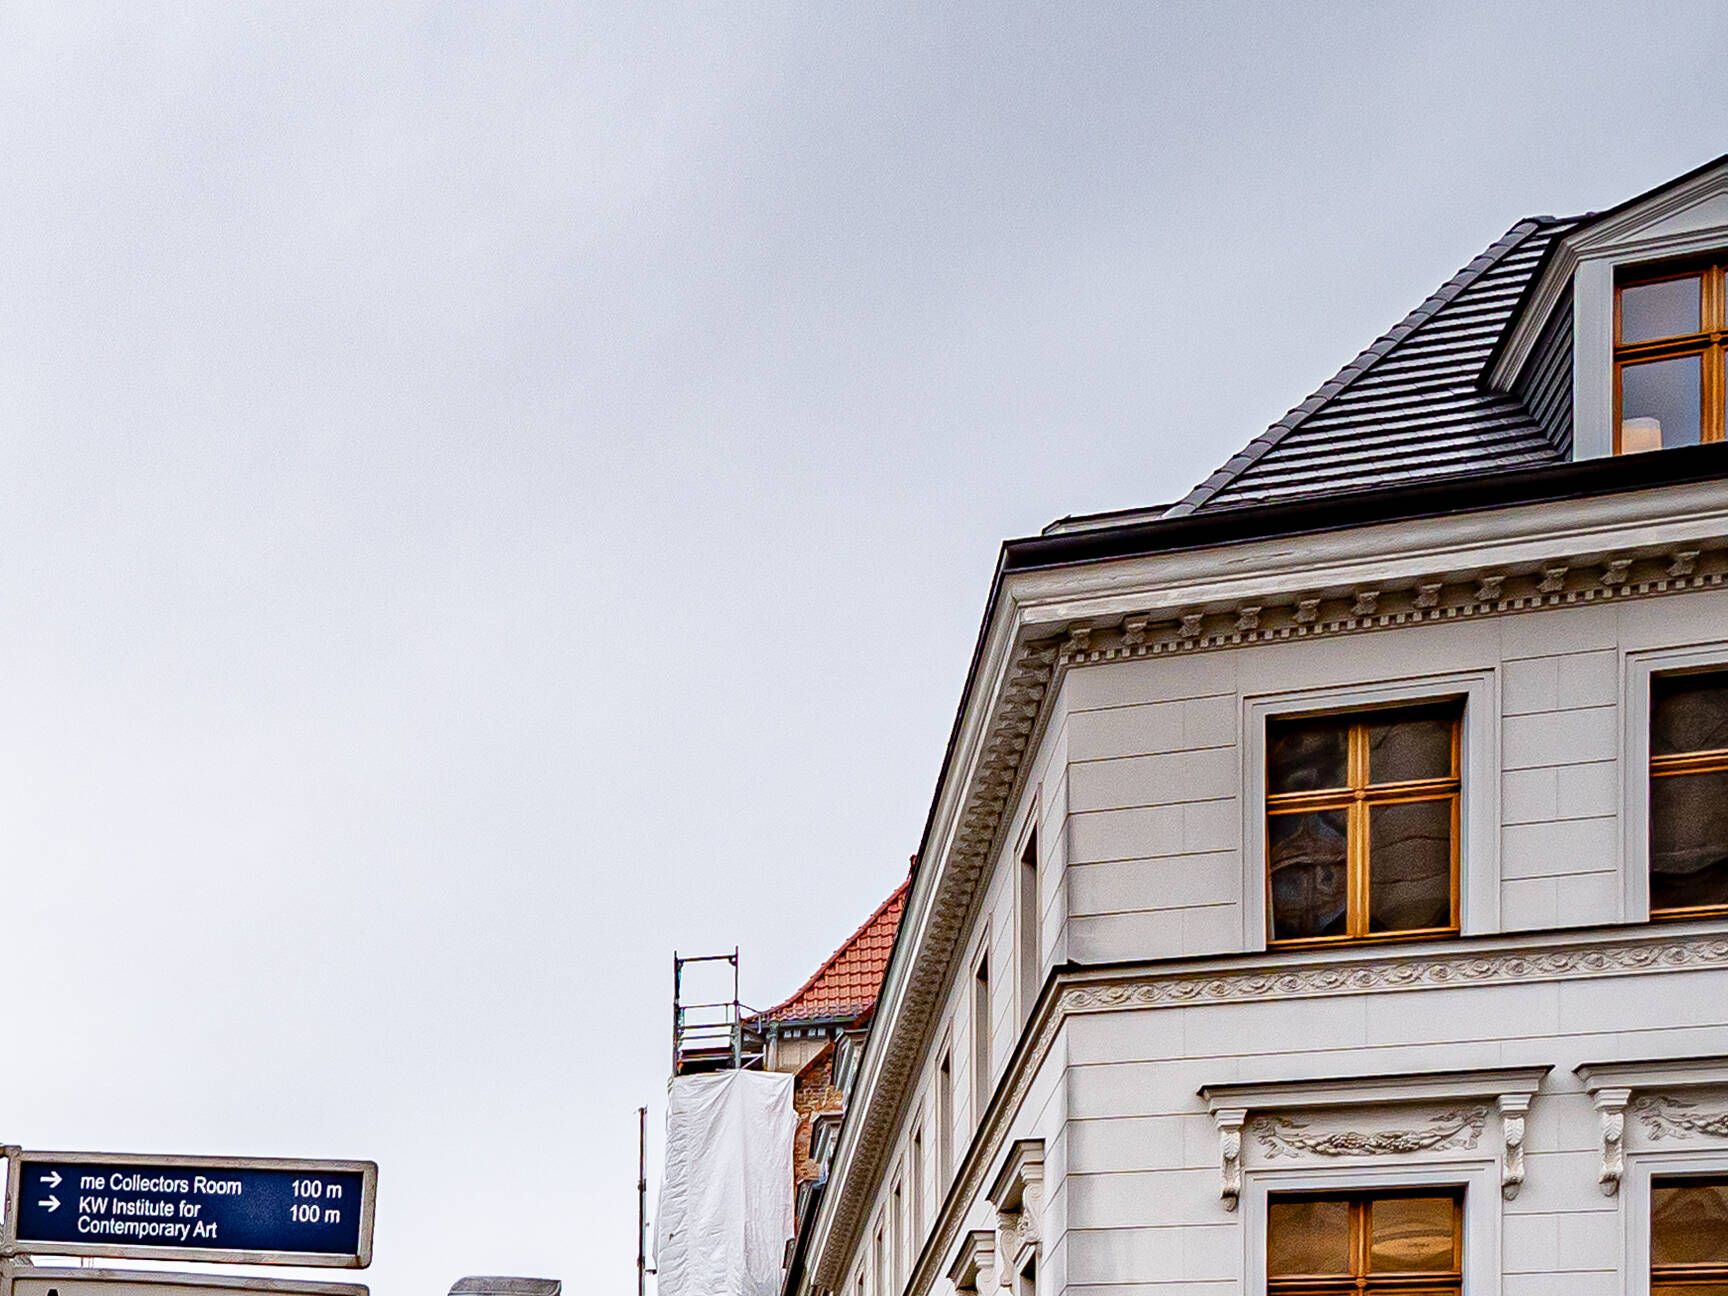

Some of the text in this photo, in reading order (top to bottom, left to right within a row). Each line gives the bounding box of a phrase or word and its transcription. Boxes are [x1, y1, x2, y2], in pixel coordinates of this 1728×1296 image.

[80, 1173, 343, 1199] me Collectors Room 100 m
[79, 1196, 341, 1224] KW Institute for 100 m
[77, 1216, 218, 1241] Contemporary Art
